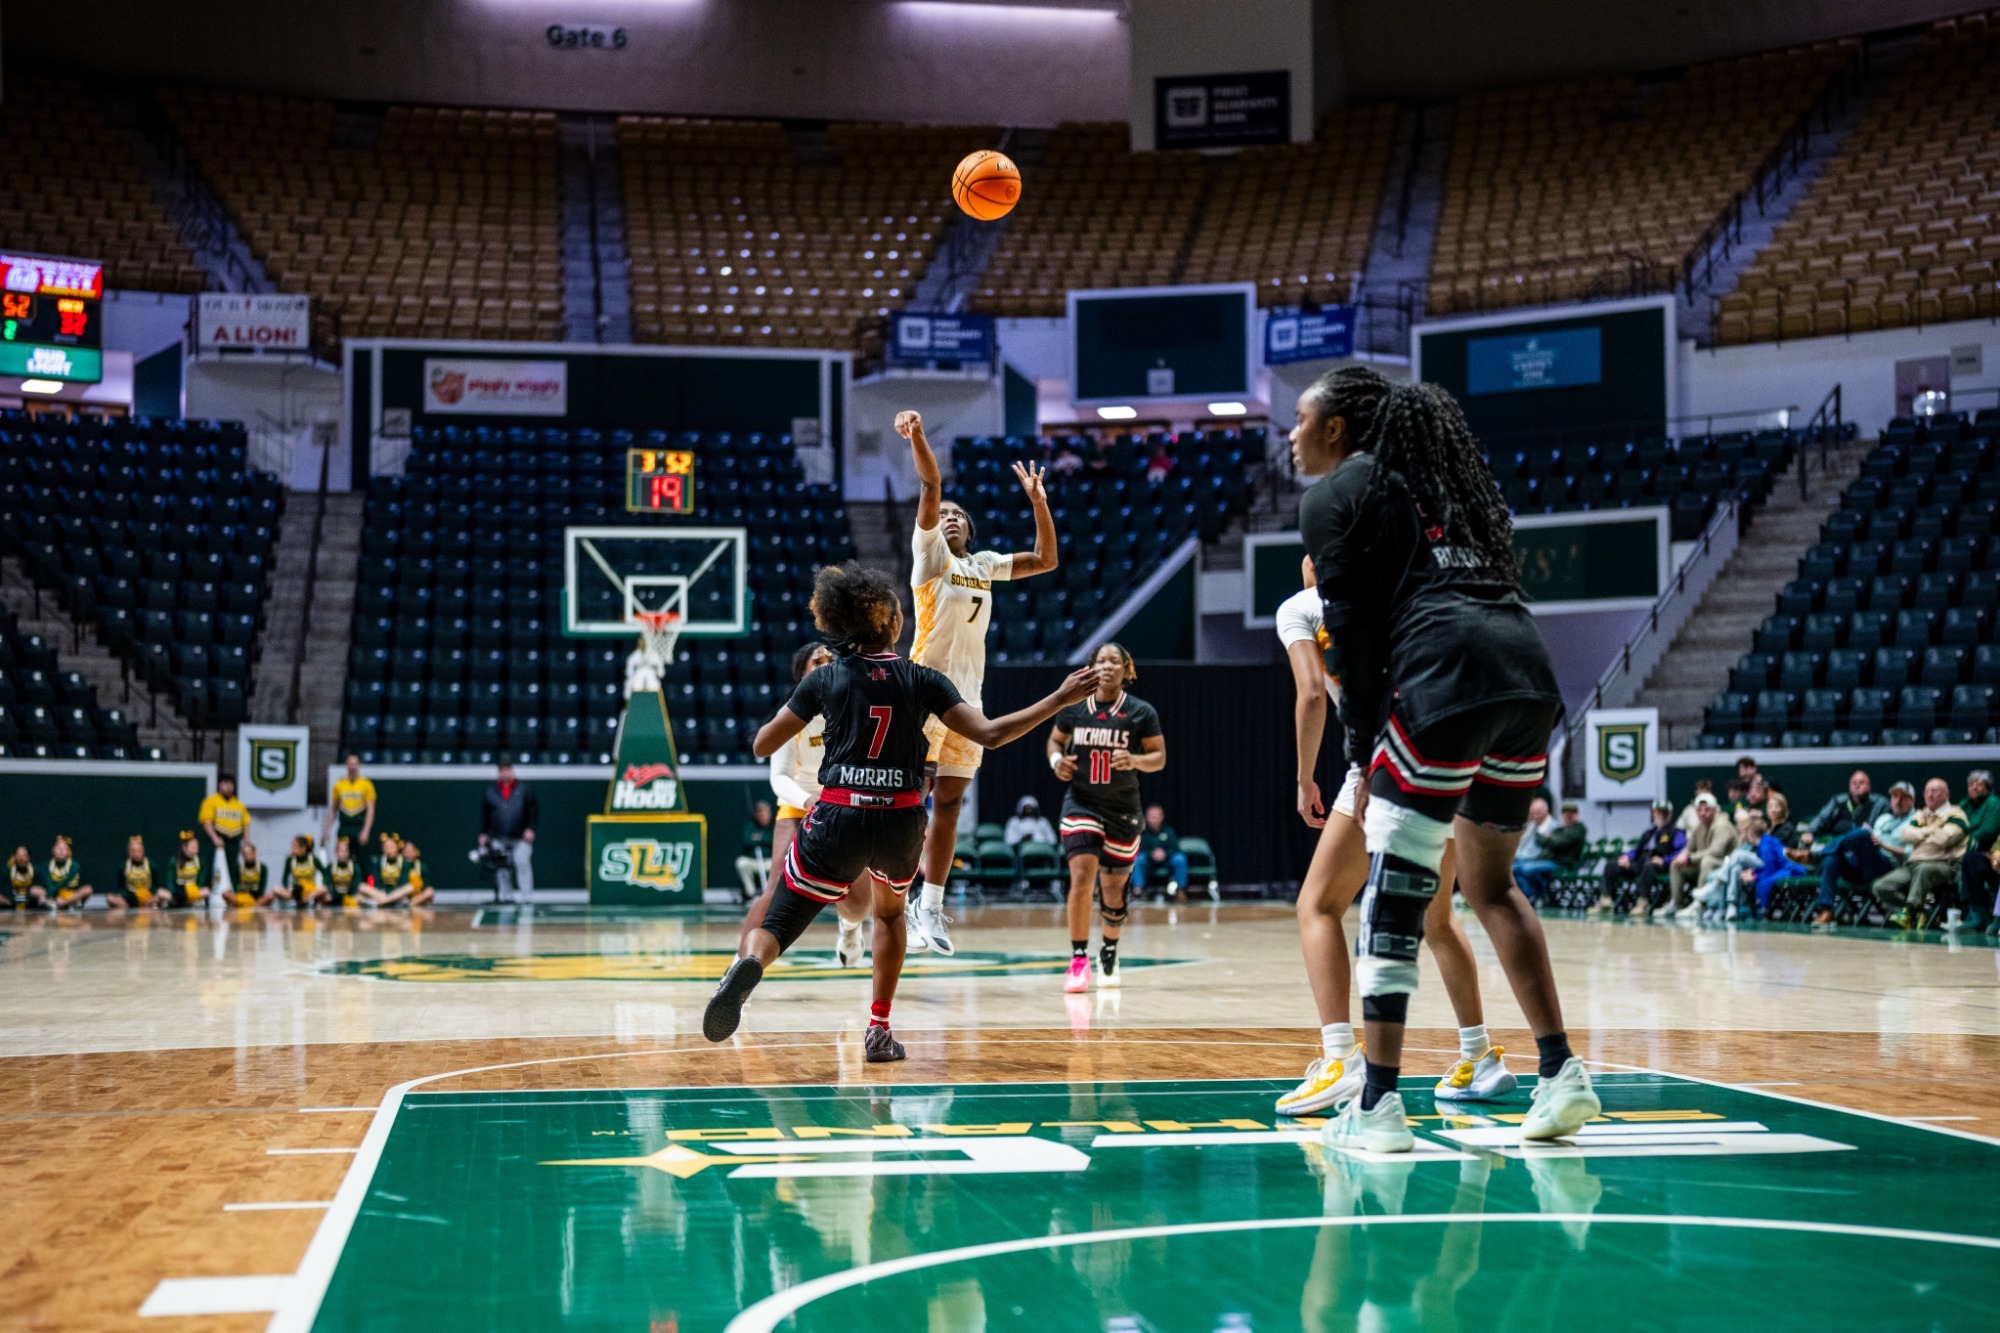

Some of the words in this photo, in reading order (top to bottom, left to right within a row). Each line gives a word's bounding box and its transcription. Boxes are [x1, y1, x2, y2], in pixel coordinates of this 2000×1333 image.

[546, 24, 606, 50] Gate
[613, 27, 628, 50] 6
[213, 326, 230, 342] A
[235, 326, 298, 344] LION!
[651, 475, 683, 511] 19
[967, 596, 983, 623] 7
[867, 705, 893, 759] 7
[1073, 727, 1130, 748] NICHOLLS
[261, 749, 286, 780] S
[1089, 749, 1112, 784] 11
[1609, 734, 1635, 768] S
[839, 765, 904, 788] MORRIS
[599, 838, 694, 887] SLU
